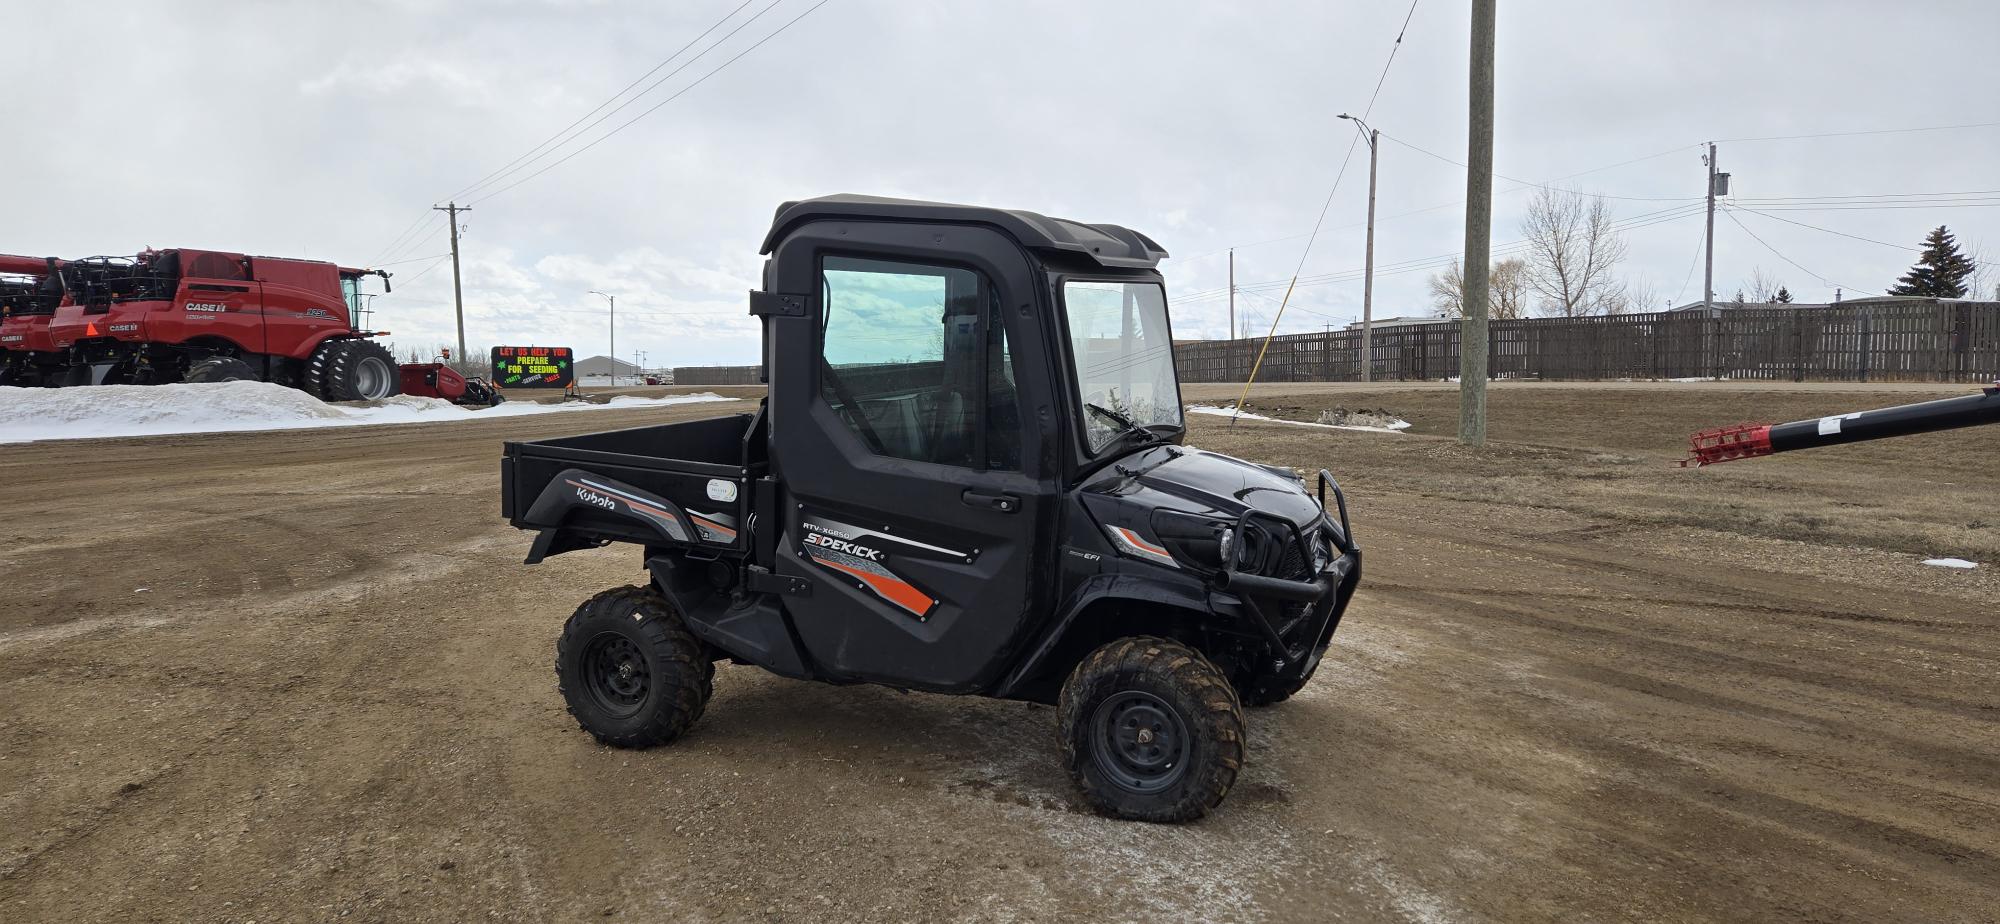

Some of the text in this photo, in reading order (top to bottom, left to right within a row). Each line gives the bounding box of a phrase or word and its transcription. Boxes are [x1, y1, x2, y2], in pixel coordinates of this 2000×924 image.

[185, 303, 216, 311] CASE
[500, 347, 567, 356] LET US HELP YOU
[517, 356, 549, 364] PREPARE
[508, 365, 558, 374] FOR SEEDING
[576, 487, 616, 510] Kubota
[803, 522, 850, 539] RTV-XG850
[804, 532, 880, 561] SIDEKICK
[1084, 553, 1100, 561] EFI
